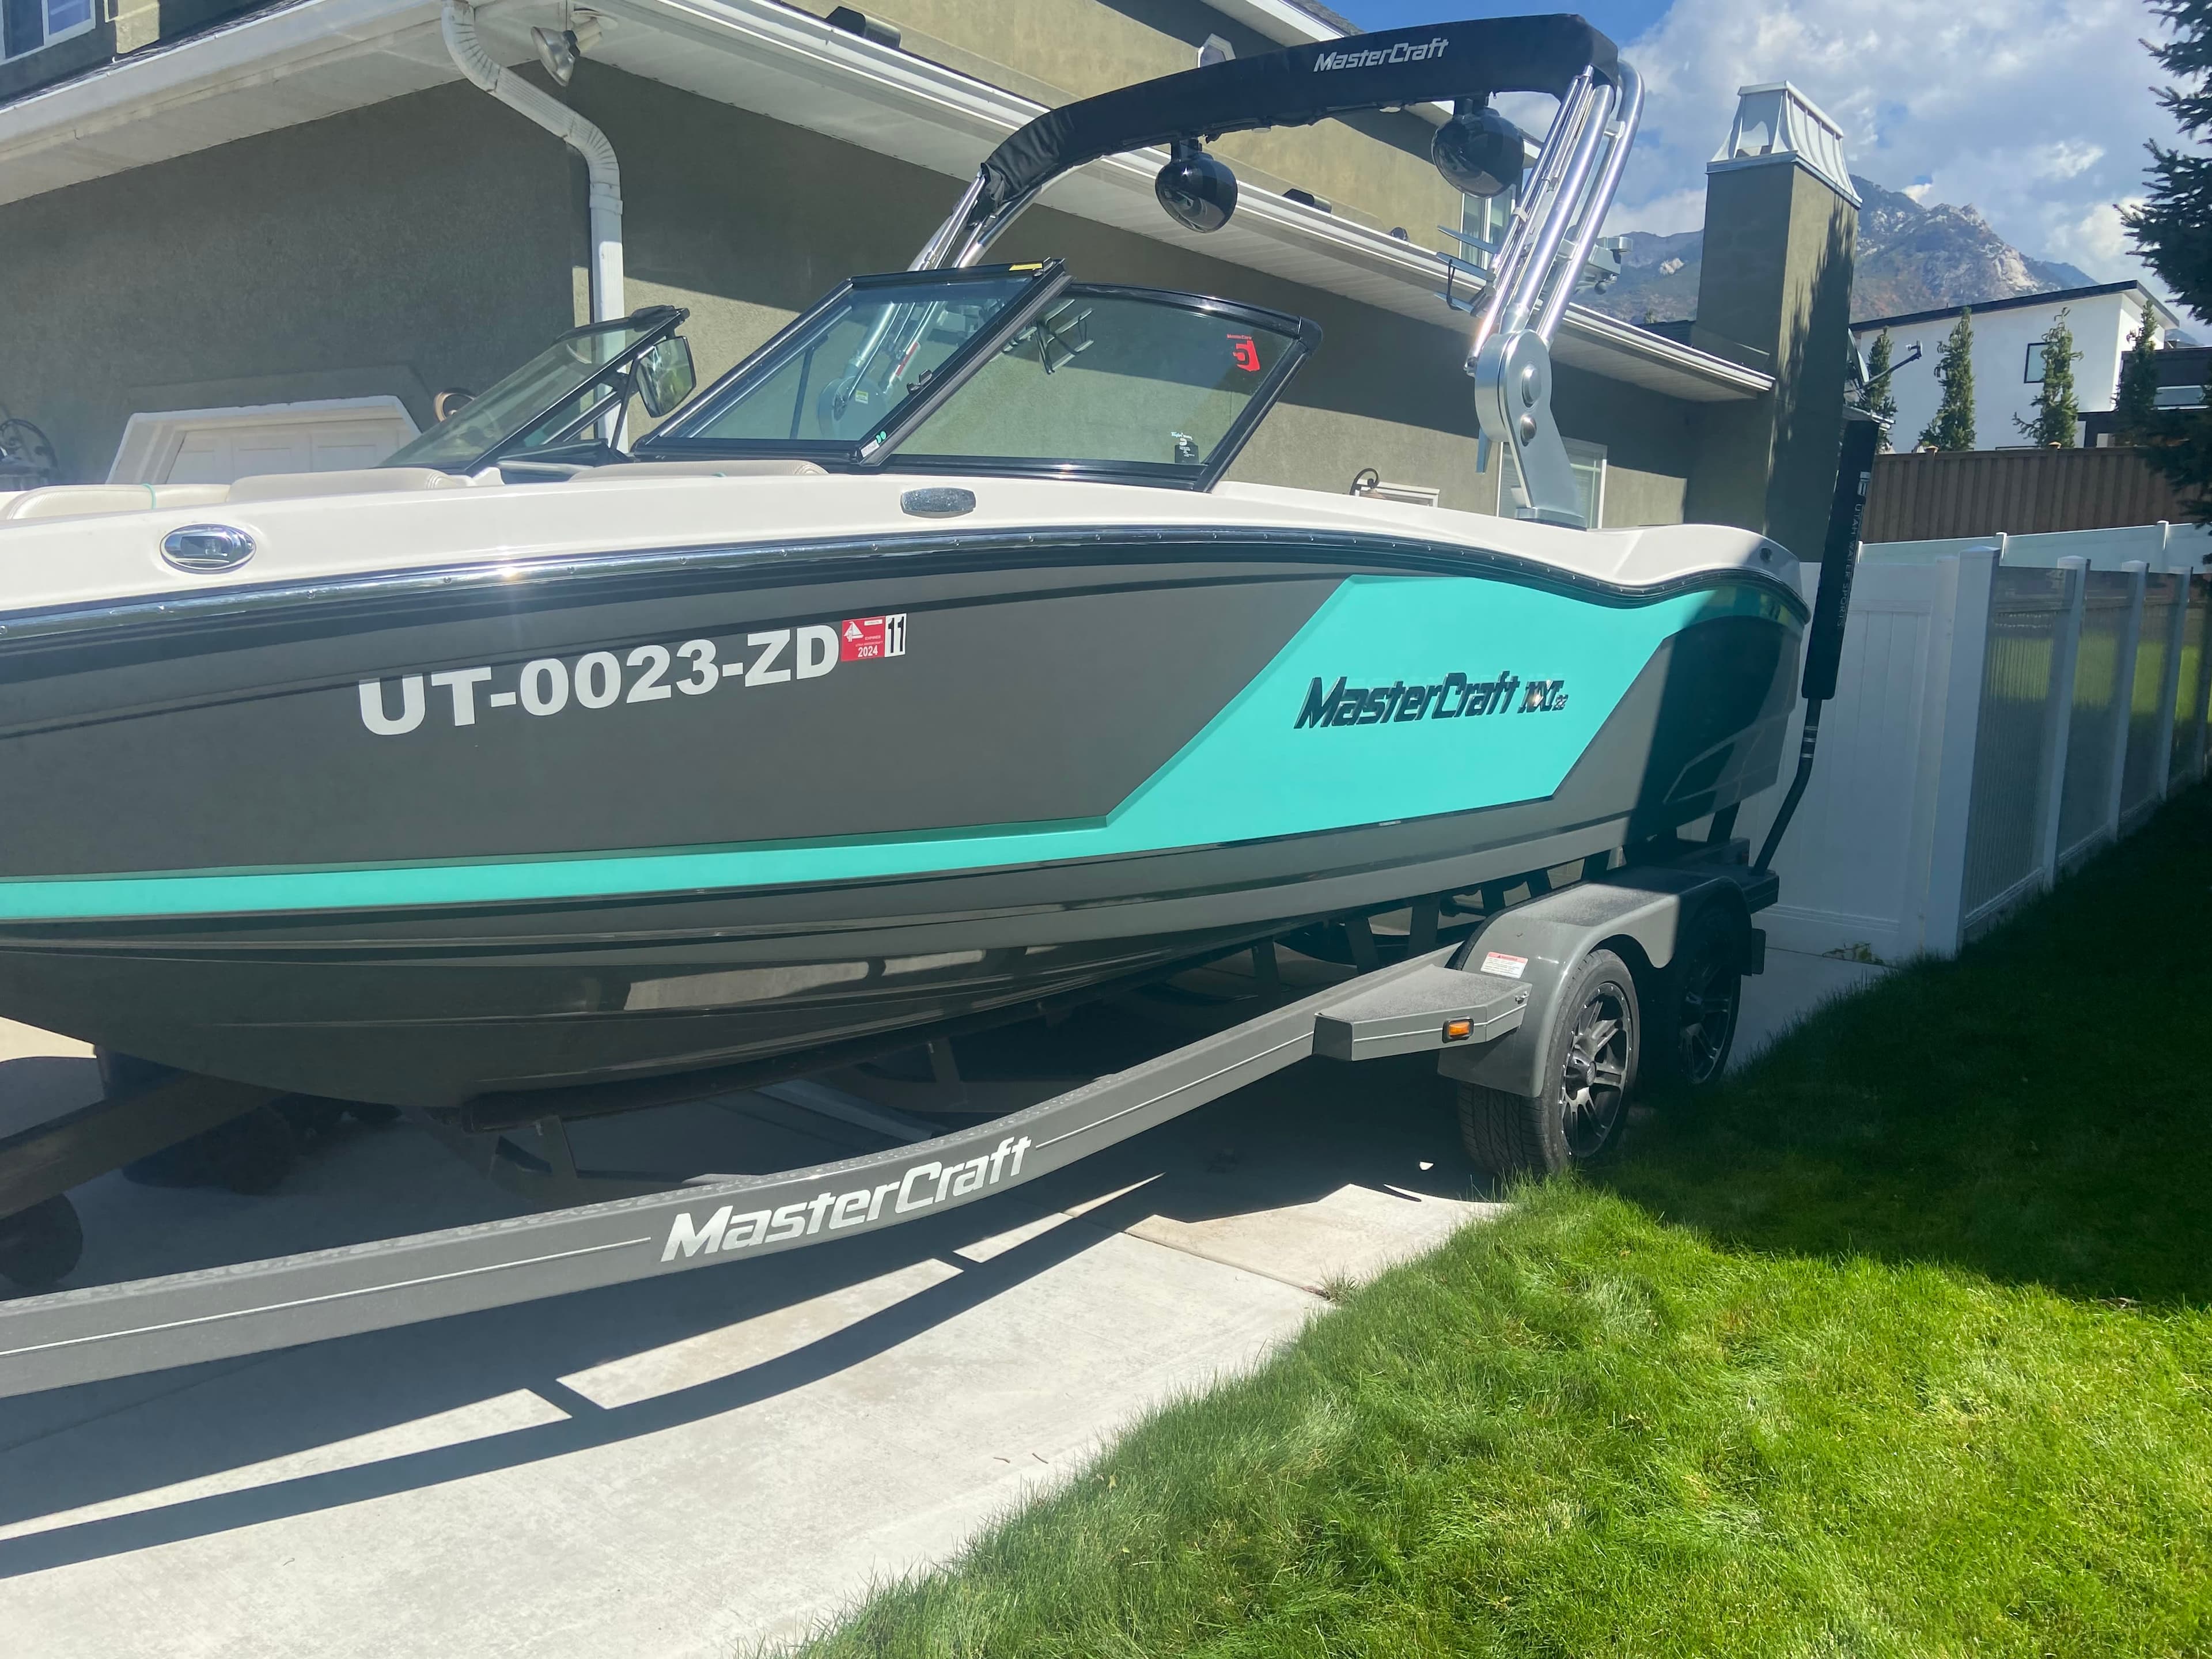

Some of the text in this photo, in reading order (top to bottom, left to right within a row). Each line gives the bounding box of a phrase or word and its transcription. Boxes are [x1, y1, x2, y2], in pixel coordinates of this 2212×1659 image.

[1313, 37, 1449, 72] MasterCraft
[1837, 504, 1862, 627] UTAH WATER SPORTS
[857, 645, 878, 658] 2024
[888, 616, 904, 654] 11
[358, 624, 839, 736] UT-0023-ZD
[1293, 670, 1521, 729] MasterCraft
[660, 1135, 1032, 1263] MasterCraft
